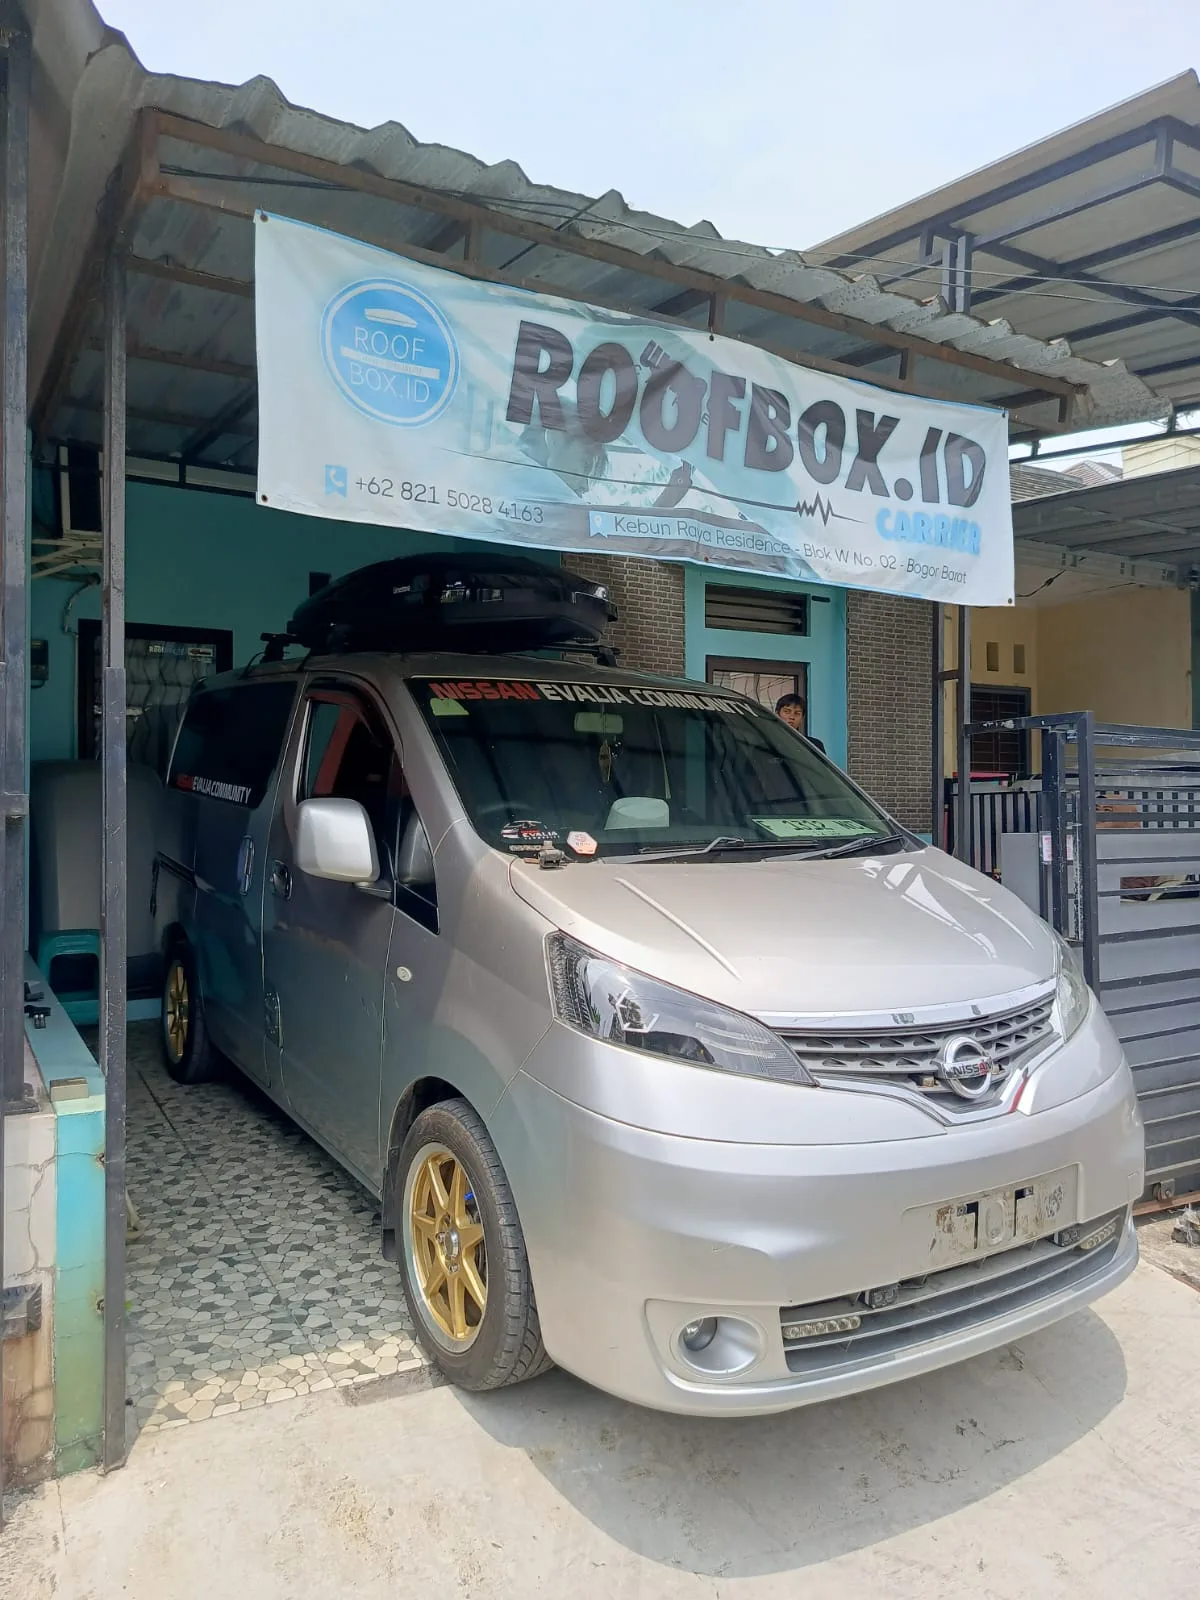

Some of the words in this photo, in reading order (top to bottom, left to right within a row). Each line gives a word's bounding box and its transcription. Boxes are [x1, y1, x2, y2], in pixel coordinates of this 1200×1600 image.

[354, 326, 426, 361] ROOF
[349, 361, 430, 403] BOX.ID
[505, 319, 987, 508] ROOFBOX.ID
[355, 476, 394, 498] +62
[400, 481, 440, 505] 821
[447, 489, 493, 514] 5028
[498, 501, 544, 524] 4163
[614, 515, 671, 536] Kebun
[677, 520, 712, 544] Raya
[716, 529, 790, 553] Residence
[803, 543, 831, 560] Blok
[835, 549, 849, 564] W
[853, 551, 877, 567] No.
[879, 554, 897, 570] 02
[906, 558, 940, 579] Bogor
[941, 565, 967, 584] Barat
[428, 682, 541, 700] NISSAN
[536, 683, 635, 705] EVALIA
[629, 689, 759, 718] COMMUNITY
[210, 781, 252, 804] COMMUNITY
